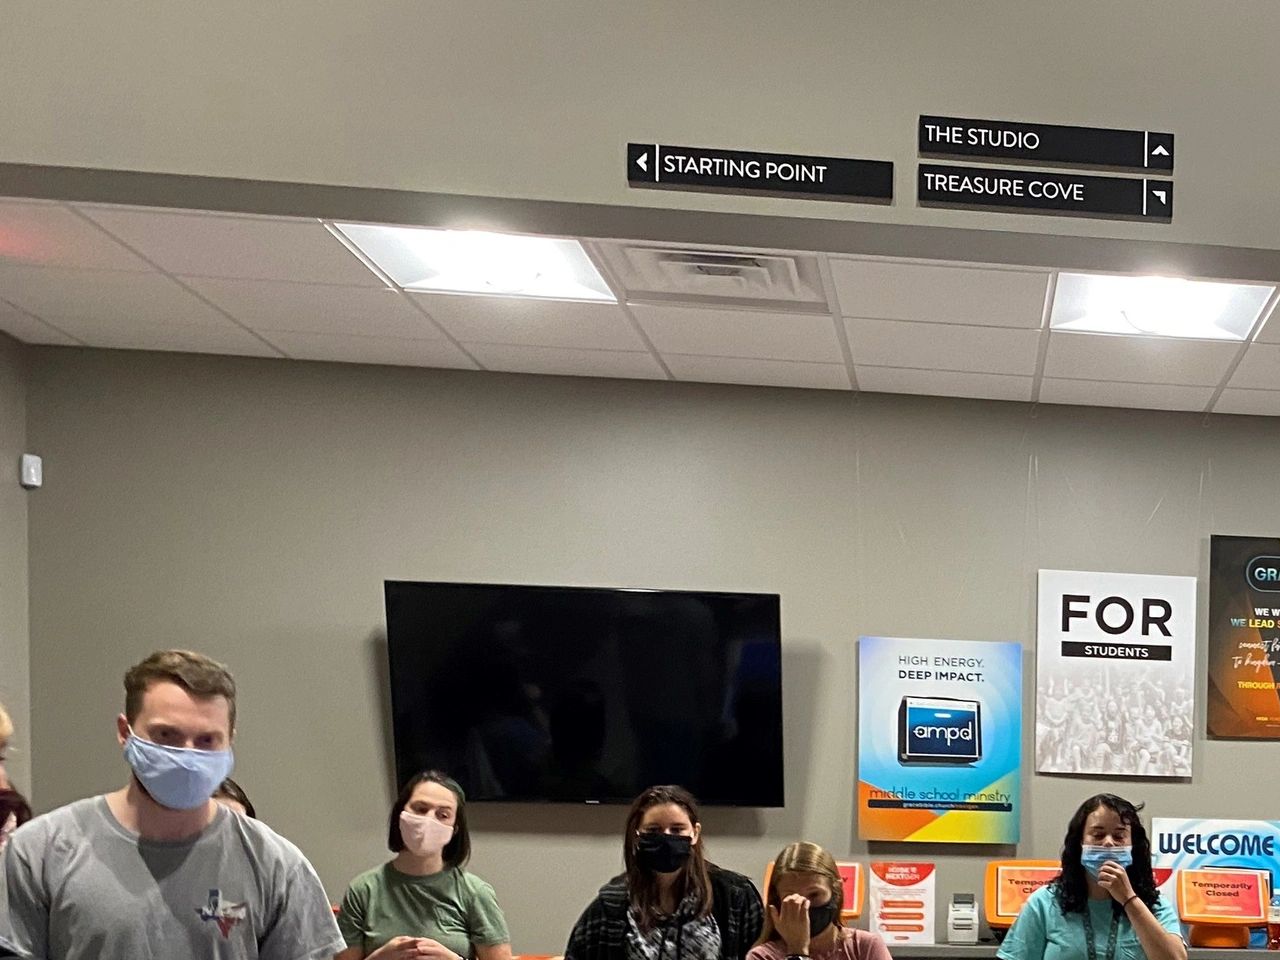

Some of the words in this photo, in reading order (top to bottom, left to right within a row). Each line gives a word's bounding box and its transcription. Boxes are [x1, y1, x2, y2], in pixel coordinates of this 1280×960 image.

[924, 125, 963, 145] THE
[966, 129, 1041, 150] STUDIO
[663, 155, 762, 179] STARTING
[764, 163, 828, 184] POINT
[924, 173, 1025, 198] TREASURE
[1028, 180, 1084, 201] COVE
[1061, 594, 1173, 637] FOR
[1254, 607, 1270, 617] WE
[1230, 618, 1246, 627] WE
[1249, 619, 1275, 629] LEAD
[1084, 645, 1149, 658] STUDENTS
[899, 656, 929, 666] HIGH
[934, 657, 985, 668] ENERGY.
[899, 670, 932, 680] DEEP
[935, 671, 985, 682] IMPACT.
[1237, 681, 1275, 690] THROUGH
[913, 721, 972, 746] ampd
[869, 786, 916, 800] middle
[919, 788, 960, 801] school
[963, 790, 1011, 806] ministry
[1159, 833, 1275, 857] WELCOME
[1192, 881, 1253, 891] Temporarily
[1205, 890, 1240, 898] Closed
